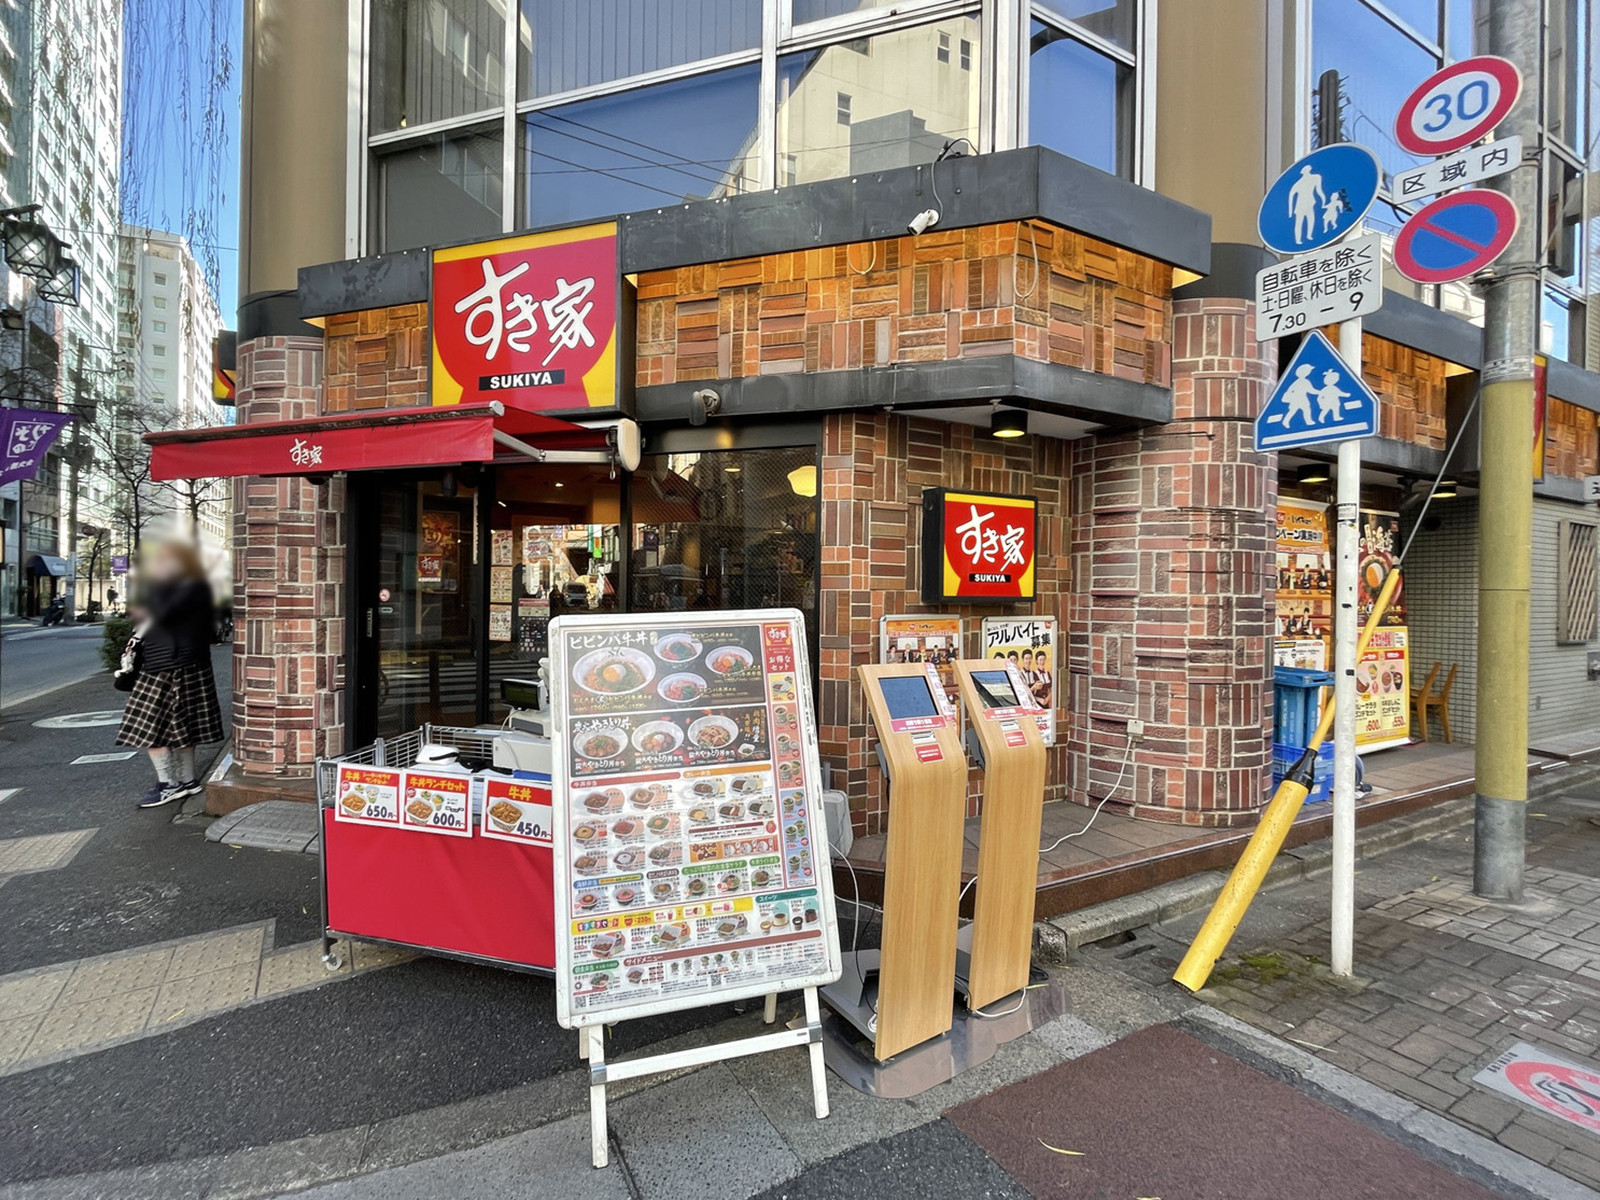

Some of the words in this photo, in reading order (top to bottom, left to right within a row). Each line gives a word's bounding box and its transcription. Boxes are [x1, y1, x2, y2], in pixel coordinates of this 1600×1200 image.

[1422, 80, 1489, 133] 30
[1402, 148, 1508, 195] 区域内
[1262, 244, 1372, 293] 自転車を除く
[455, 257, 596, 367] すき家
[1269, 312, 1307, 333] 7.30
[1349, 291, 1364, 312] 9
[489, 371, 553, 390] SUKIYA
[289, 438, 323, 468] すき家
[956, 504, 1025, 572] すき家
[973, 573, 1007, 583] SUKIYA
[569, 630, 649, 650] ビビンバ牛丼
[987, 621, 1040, 648] アルバイト
[1030, 632, 1051, 650] 募集
[768, 654, 791, 663] お得な
[345, 770, 360, 781] 牛丼
[410, 776, 466, 791] 牛丼ランチセット
[508, 785, 532, 801] 牛丼
[759, 894, 778, 903] スイーツ
[625, 955, 664, 966] サイドメニュー
